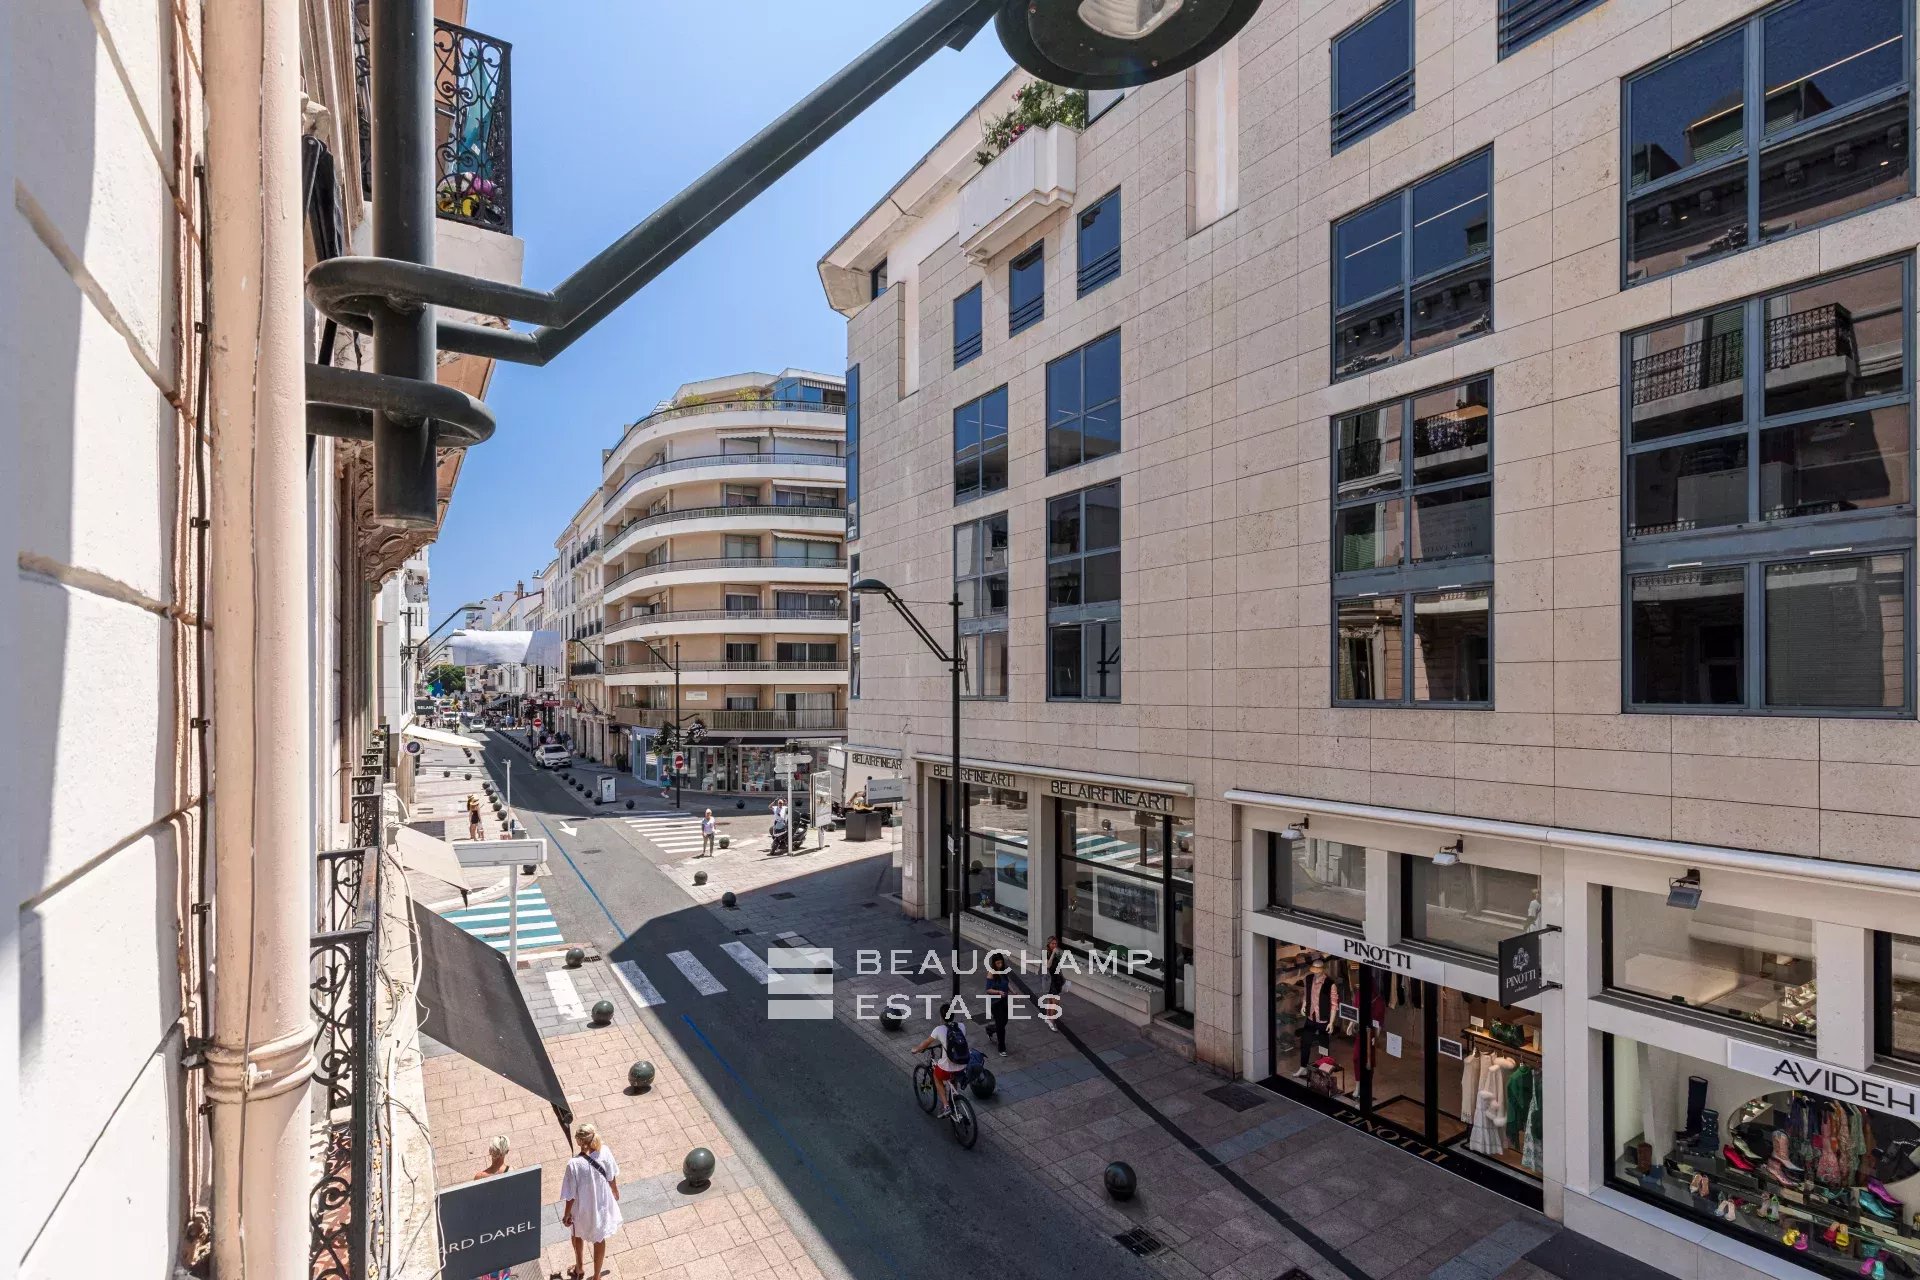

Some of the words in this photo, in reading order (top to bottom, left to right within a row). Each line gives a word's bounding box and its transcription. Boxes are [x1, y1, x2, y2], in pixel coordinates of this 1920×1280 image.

[934, 764, 1015, 787] BELRFINEART
[1343, 938, 1412, 969] PINOTTI
[1506, 968, 1536, 989] PINOTTI
[1772, 1059, 1915, 1115] AVIDEH
[1332, 1110, 1449, 1163] PINOTTI
[480, 1221, 536, 1244] DAREL
